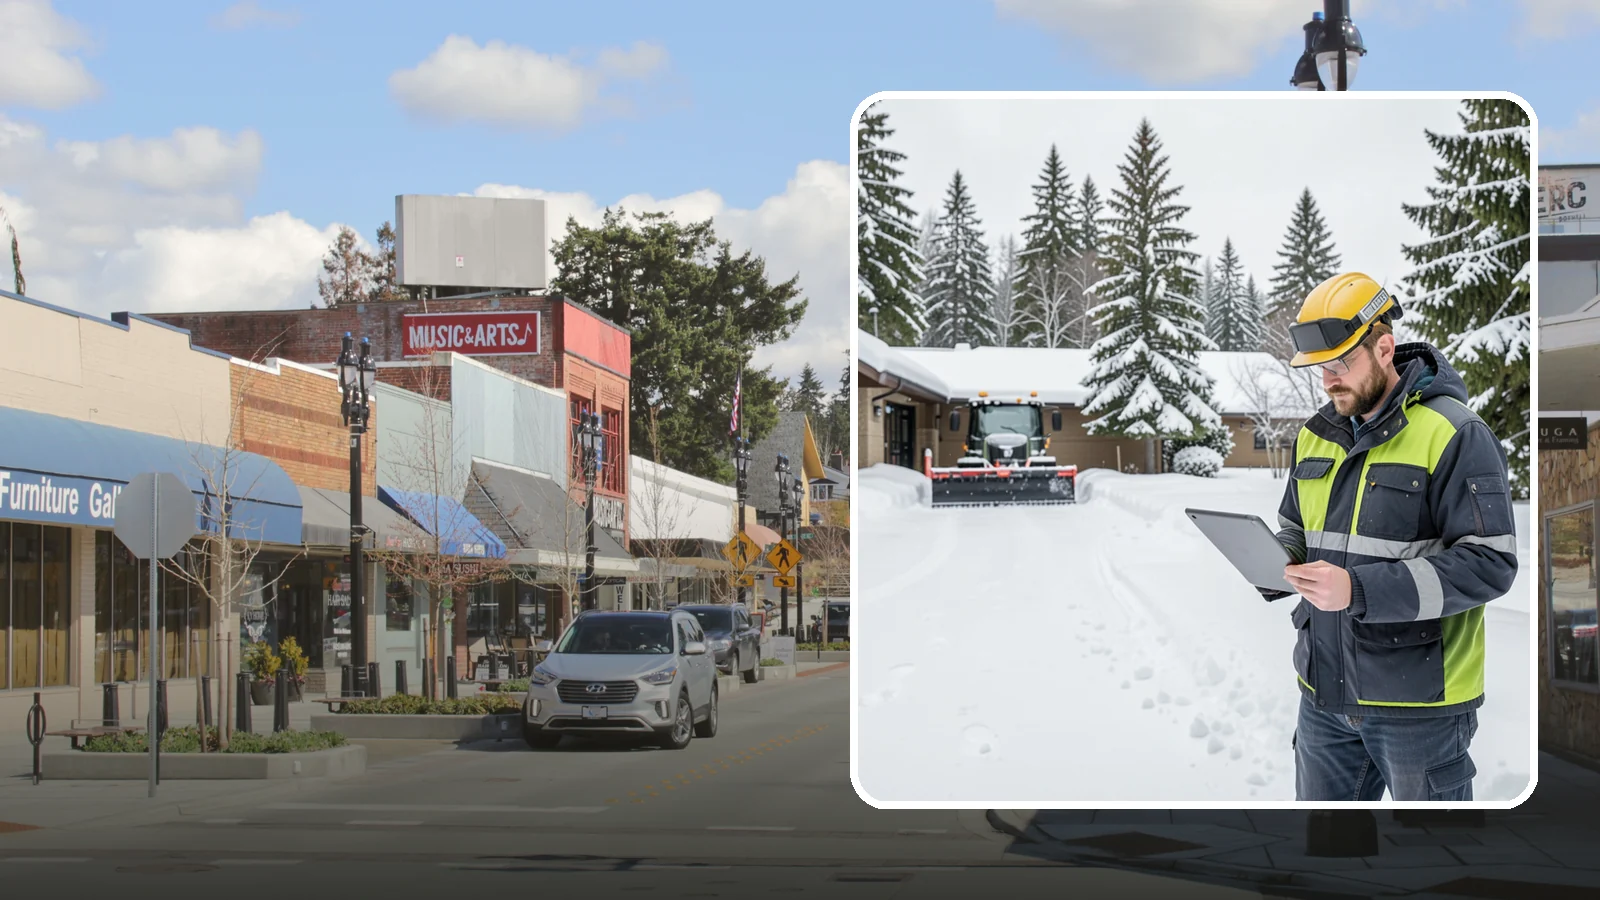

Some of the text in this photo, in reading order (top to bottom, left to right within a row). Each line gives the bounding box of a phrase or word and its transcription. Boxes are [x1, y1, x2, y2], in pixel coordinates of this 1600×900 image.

[409, 323, 519, 349] MUSIC&ARTS
[0, 471, 122, 519] Furniture Gal
[453, 563, 479, 574] SUSHI
